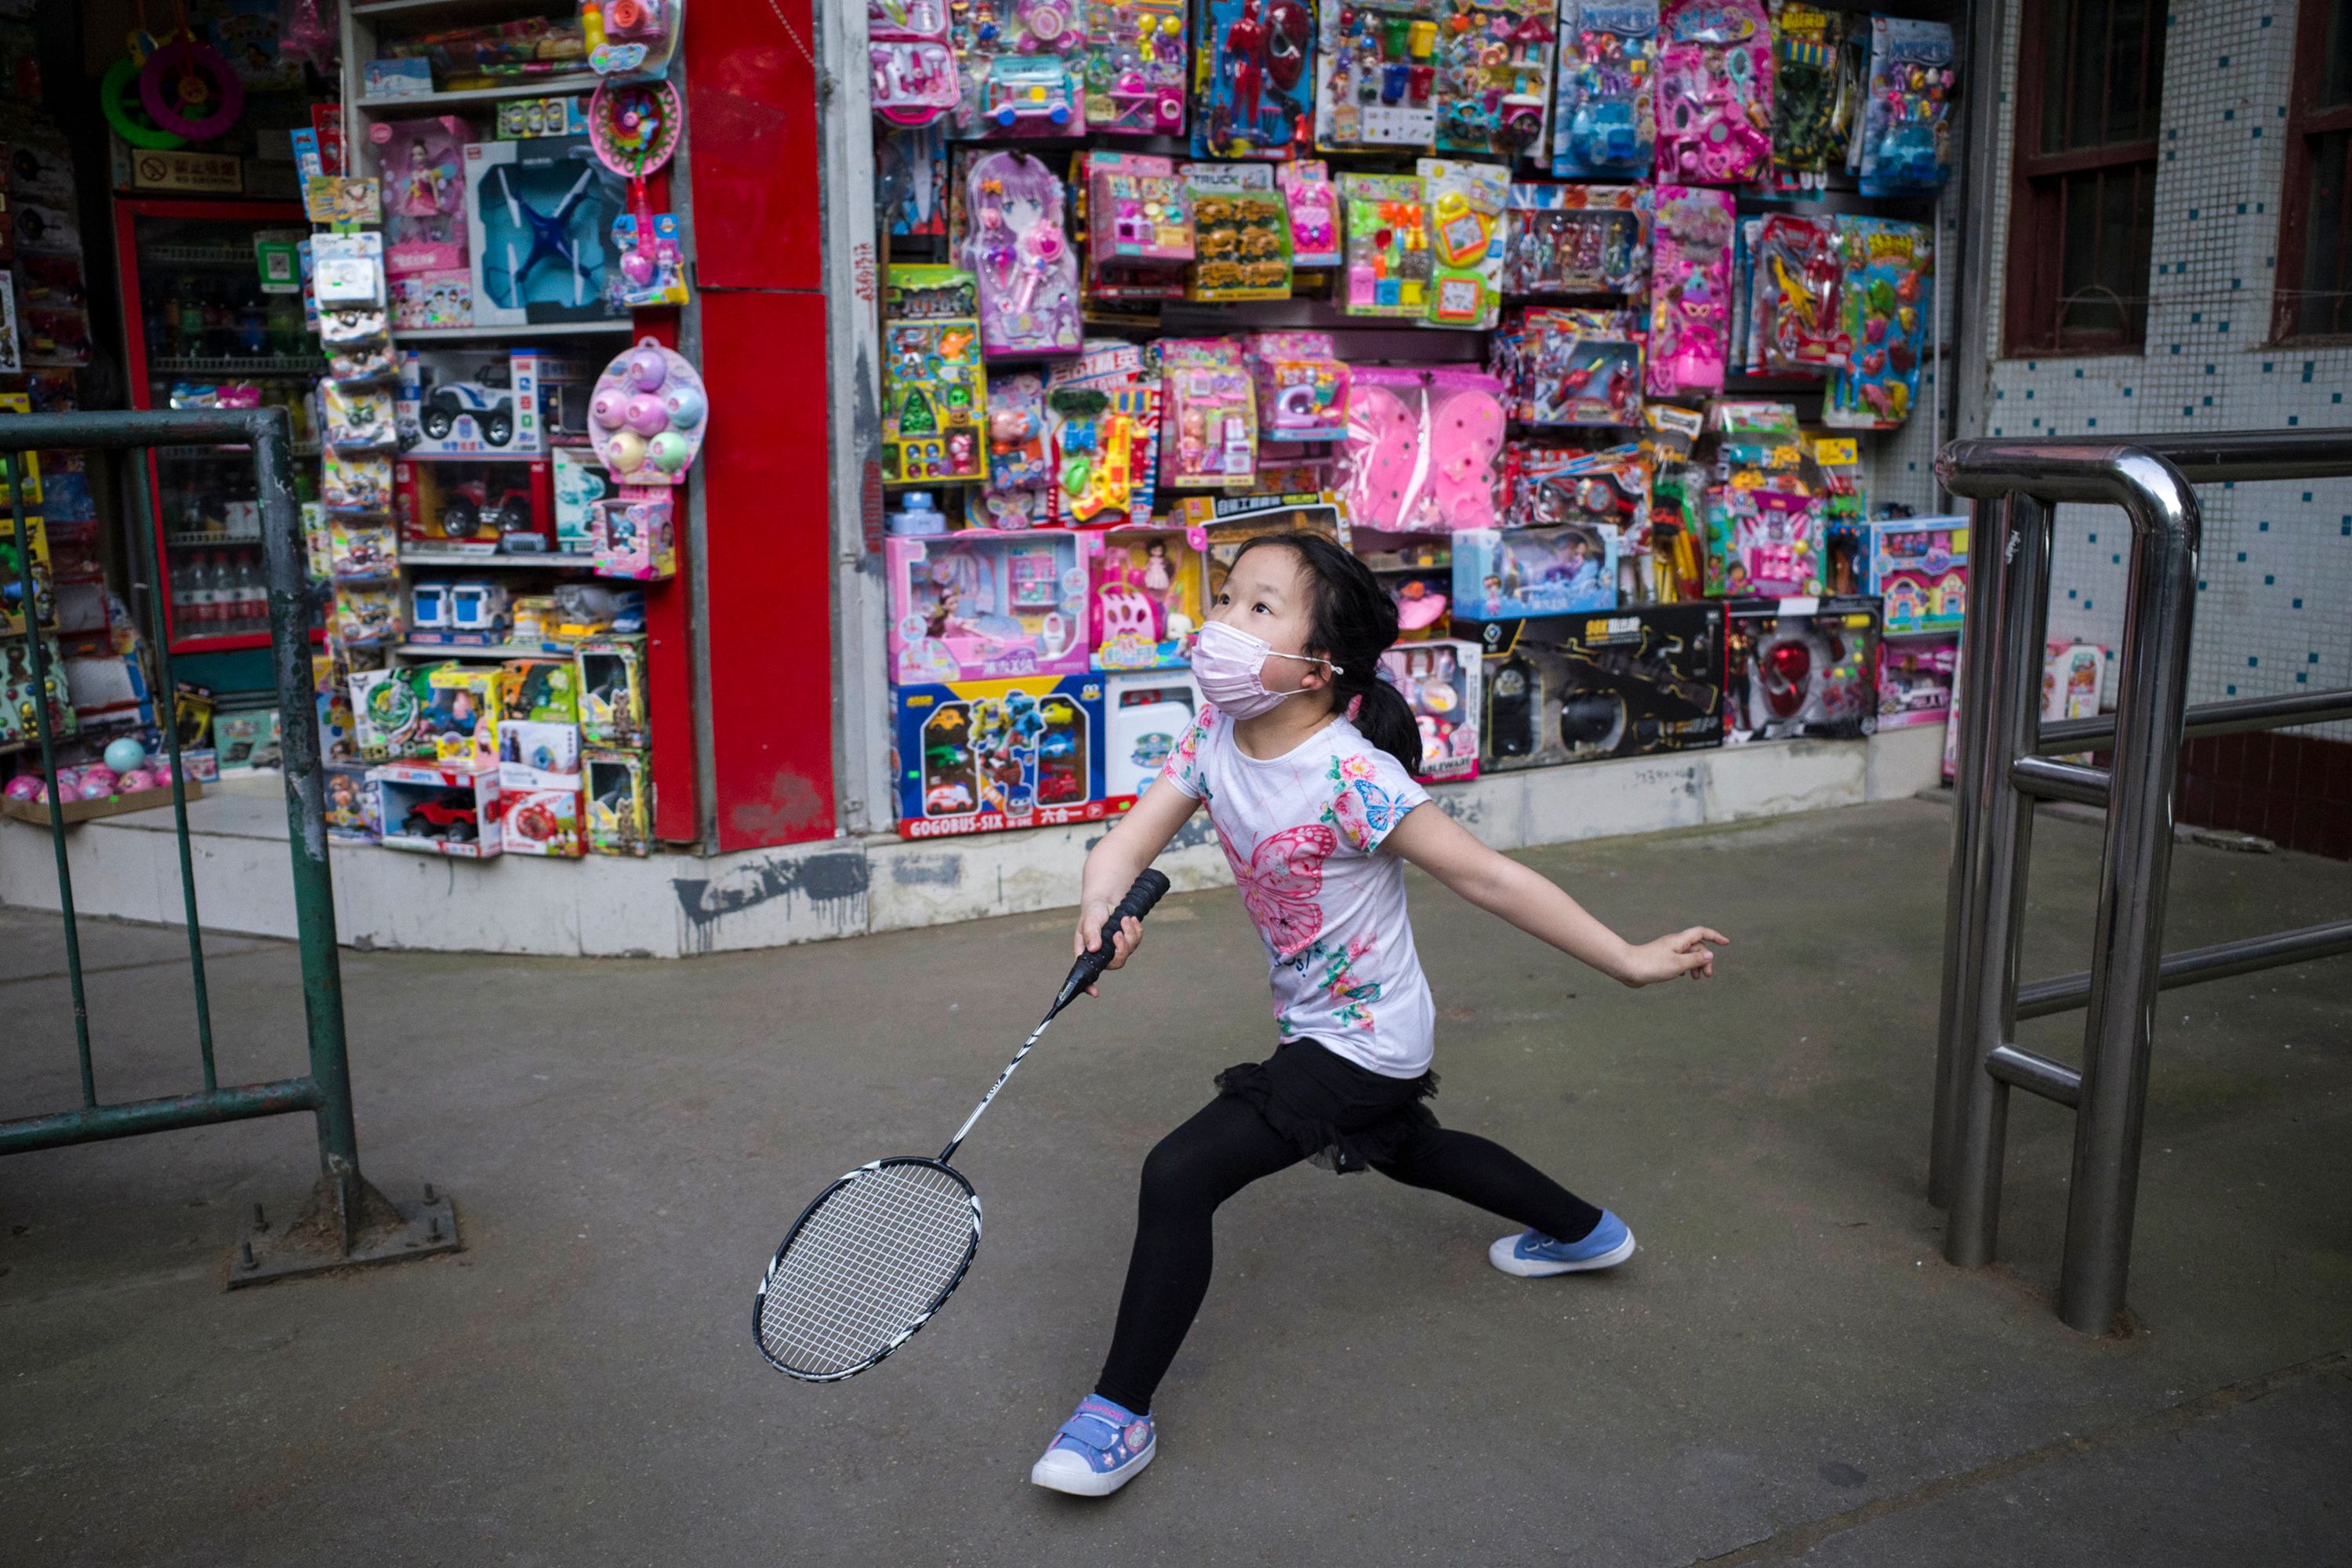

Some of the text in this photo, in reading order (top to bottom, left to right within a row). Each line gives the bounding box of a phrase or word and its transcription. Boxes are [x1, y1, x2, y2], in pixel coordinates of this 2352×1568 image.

[1421, 757, 1471, 775] ABLEWARE
[1040, 808, 1083, 824] 六合一
[910, 814, 1004, 837] GOGOBUS-SIX
